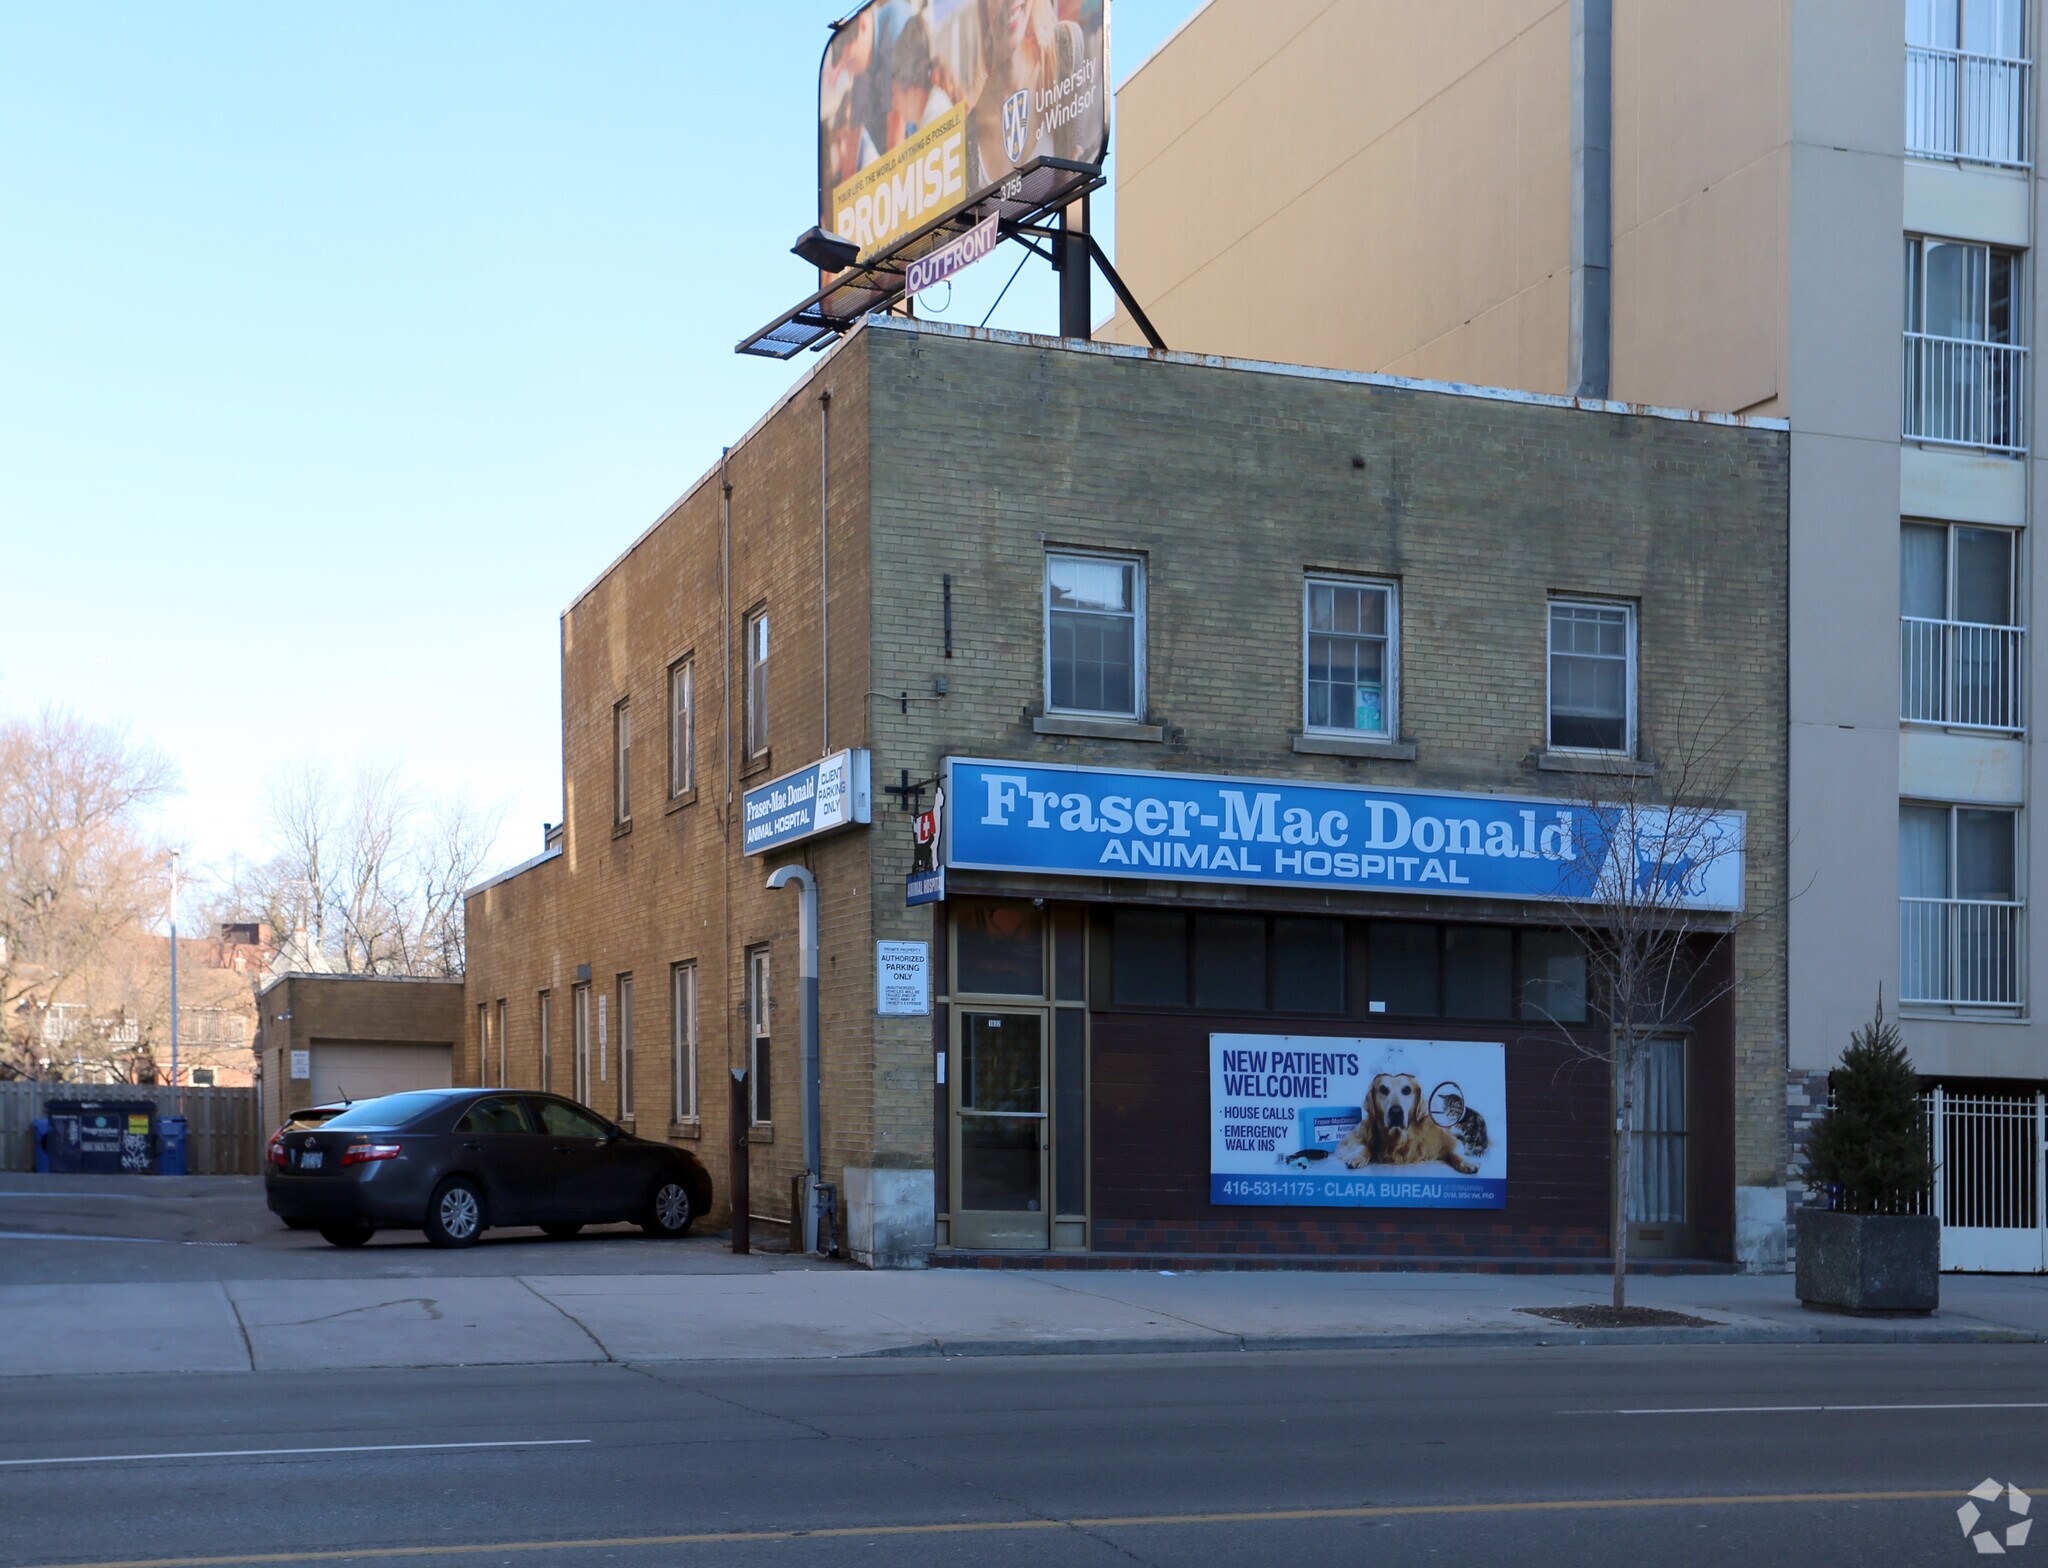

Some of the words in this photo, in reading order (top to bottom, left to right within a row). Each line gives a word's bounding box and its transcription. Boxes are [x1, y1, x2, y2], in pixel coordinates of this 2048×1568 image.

[1035, 57, 1097, 113] University
[1035, 121, 1045, 141] of
[1045, 85, 1097, 134] Windsor
[837, 189, 853, 206] YOUR
[865, 172, 876, 187] THE
[897, 137, 925, 165] ANYTHING
[925, 133, 931, 146] IS
[837, 131, 962, 255] PROMISE
[1000, 175, 1022, 202] 3755
[908, 219, 994, 291] OUTFRONT
[820, 766, 842, 785] CLIENT
[746, 790, 787, 822] Fraser-Mac
[787, 775, 815, 807] Donald
[818, 781, 846, 802] PARKING
[823, 798, 841, 815] ONLY
[980, 773, 1349, 848] Fraser-Mac
[1364, 799, 1577, 861] Donald
[747, 824, 774, 844] ANIMAL
[774, 807, 810, 835] HOSPITAL
[1099, 838, 1262, 872] ANIMAL
[1275, 848, 1470, 884] HOSPITAL
[881, 955, 925, 963] AUTHORIZED
[886, 963, 920, 972] PARKING
[893, 972, 913, 980] ONLY
[1223, 1050, 1268, 1073] NEW
[1271, 1051, 1359, 1076] PATIENTS
[1223, 1074, 1328, 1098] WELCOME!
[1224, 1106, 1260, 1119] HOUSE
[1262, 1107, 1295, 1120] CALLS
[1224, 1125, 1288, 1139] EMERGENCY
[1225, 1139, 1256, 1151] WALK
[1258, 1139, 1275, 1152] INS
[1223, 1181, 1314, 1197] 416-531-1175
[1324, 1182, 1376, 1197] CLARA
[1380, 1183, 1442, 1198] BUREAU
